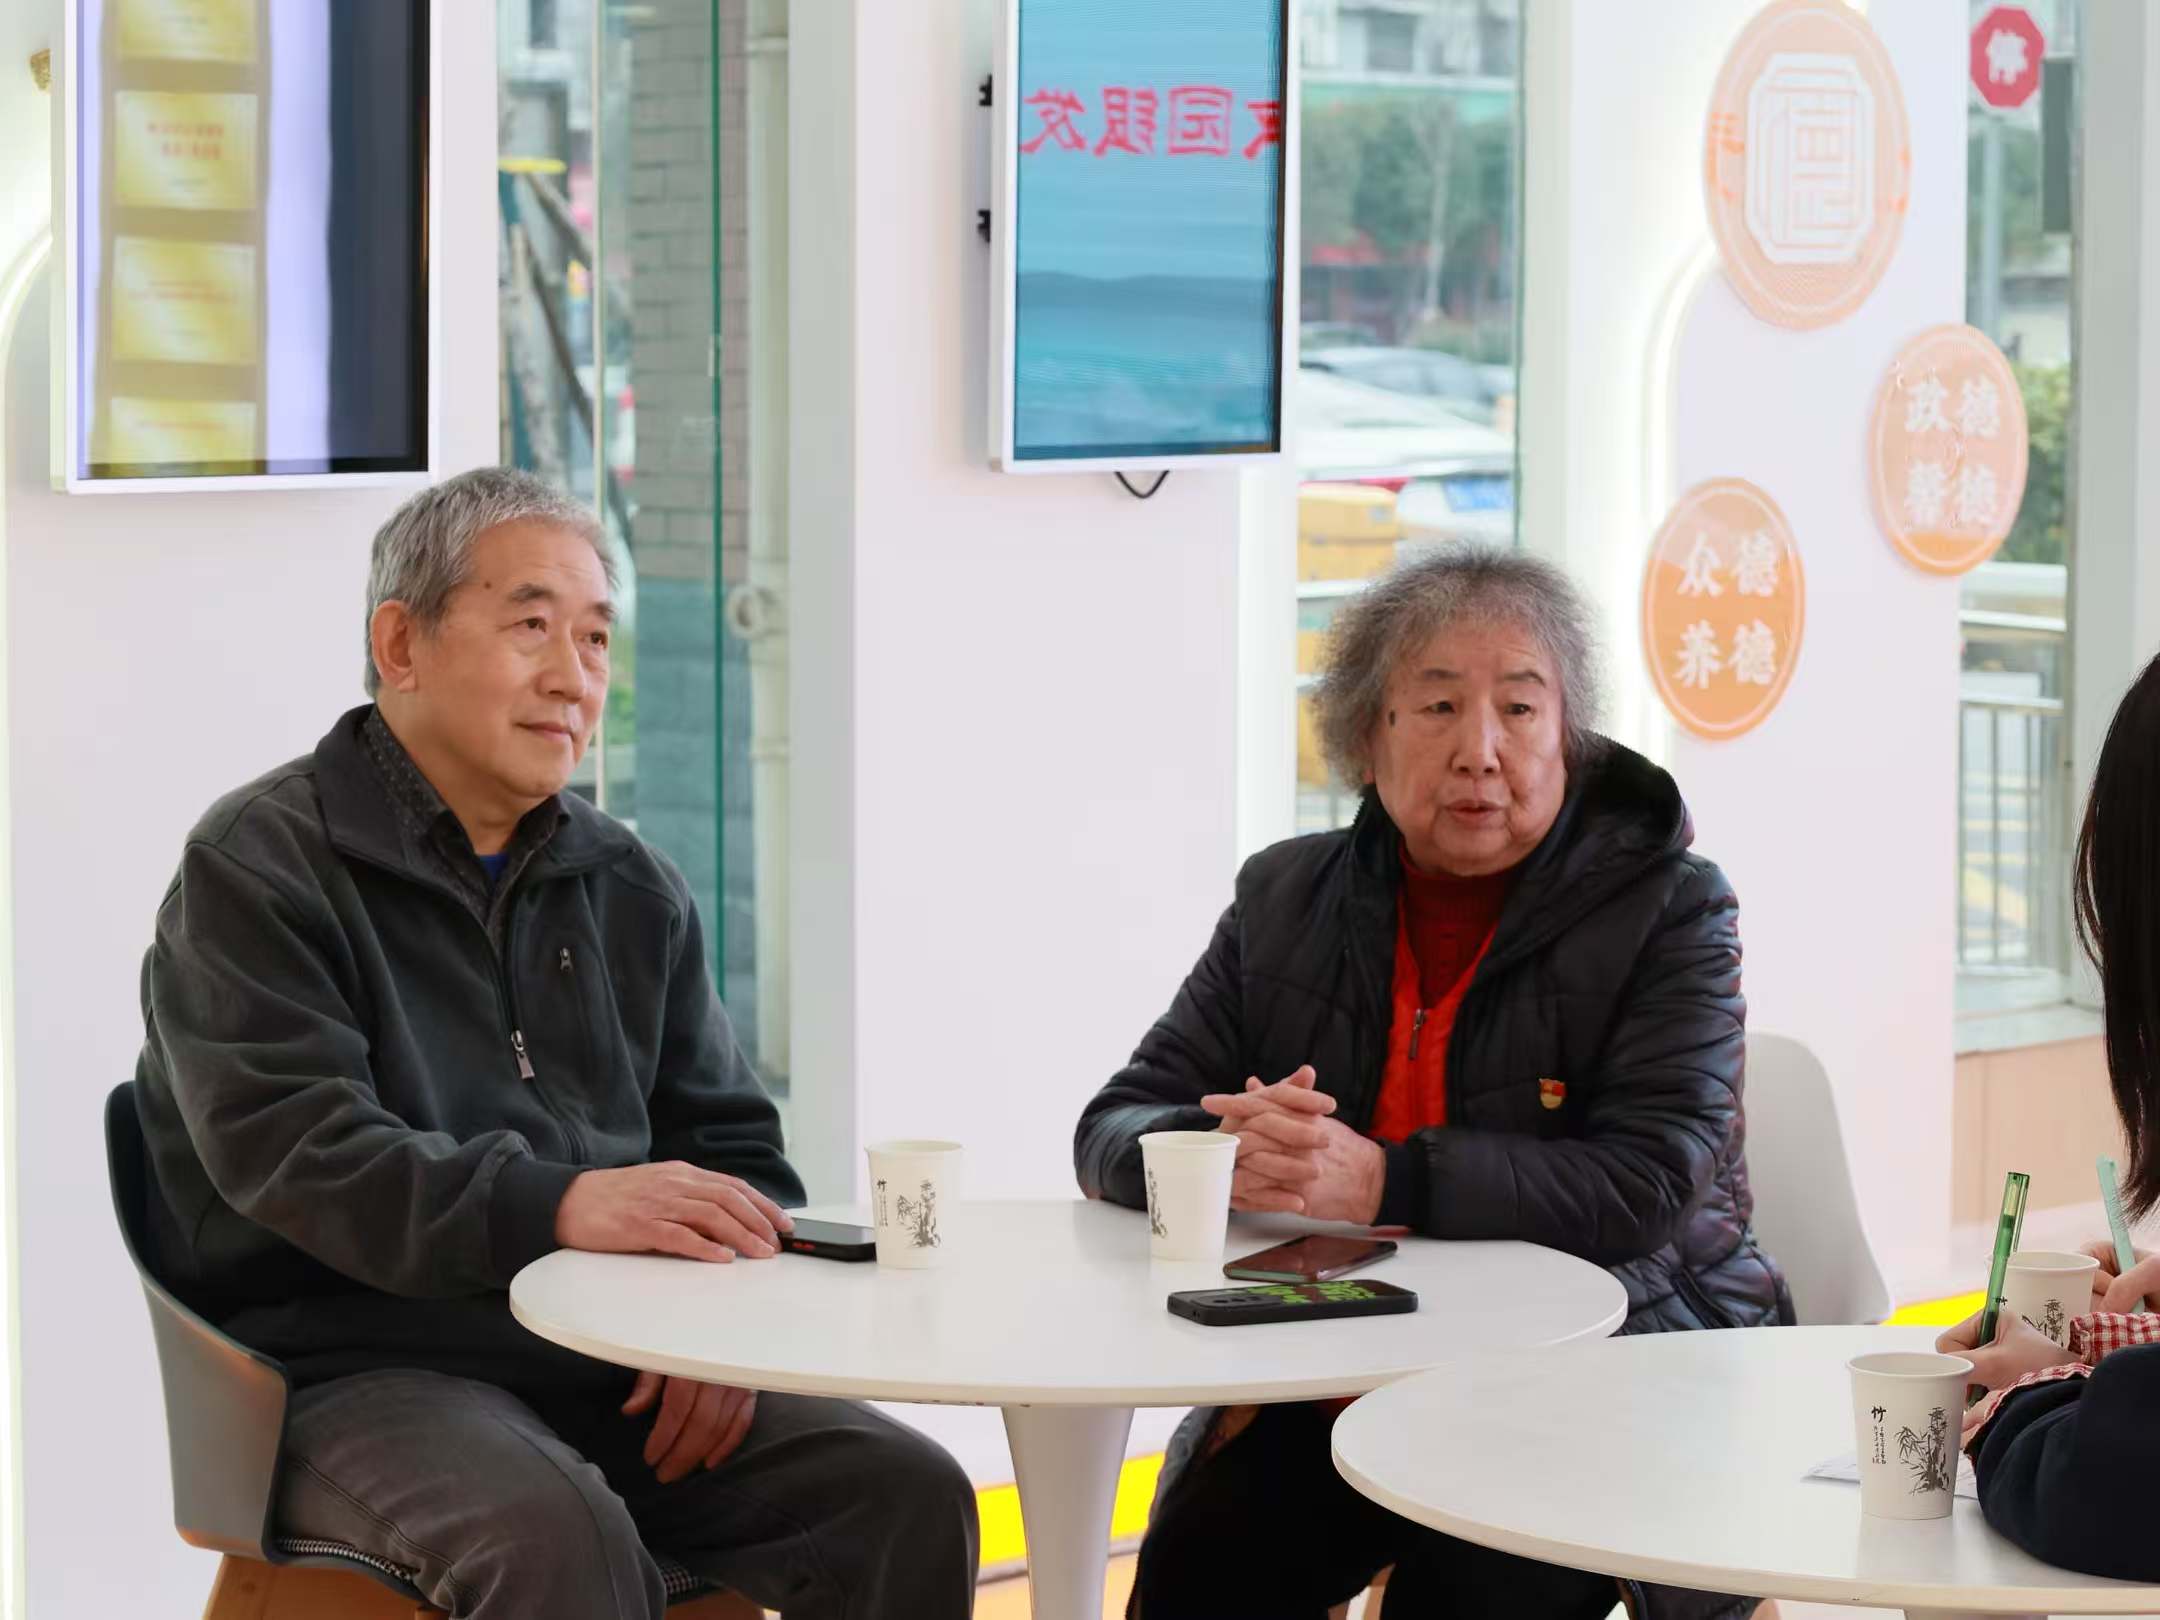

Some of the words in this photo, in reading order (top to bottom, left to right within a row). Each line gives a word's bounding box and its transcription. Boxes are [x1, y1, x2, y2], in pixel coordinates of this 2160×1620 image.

[1676, 530, 1778, 598] 众德
[1673, 619, 1776, 689] 养德
[1871, 1406, 1887, 1423] 竹
